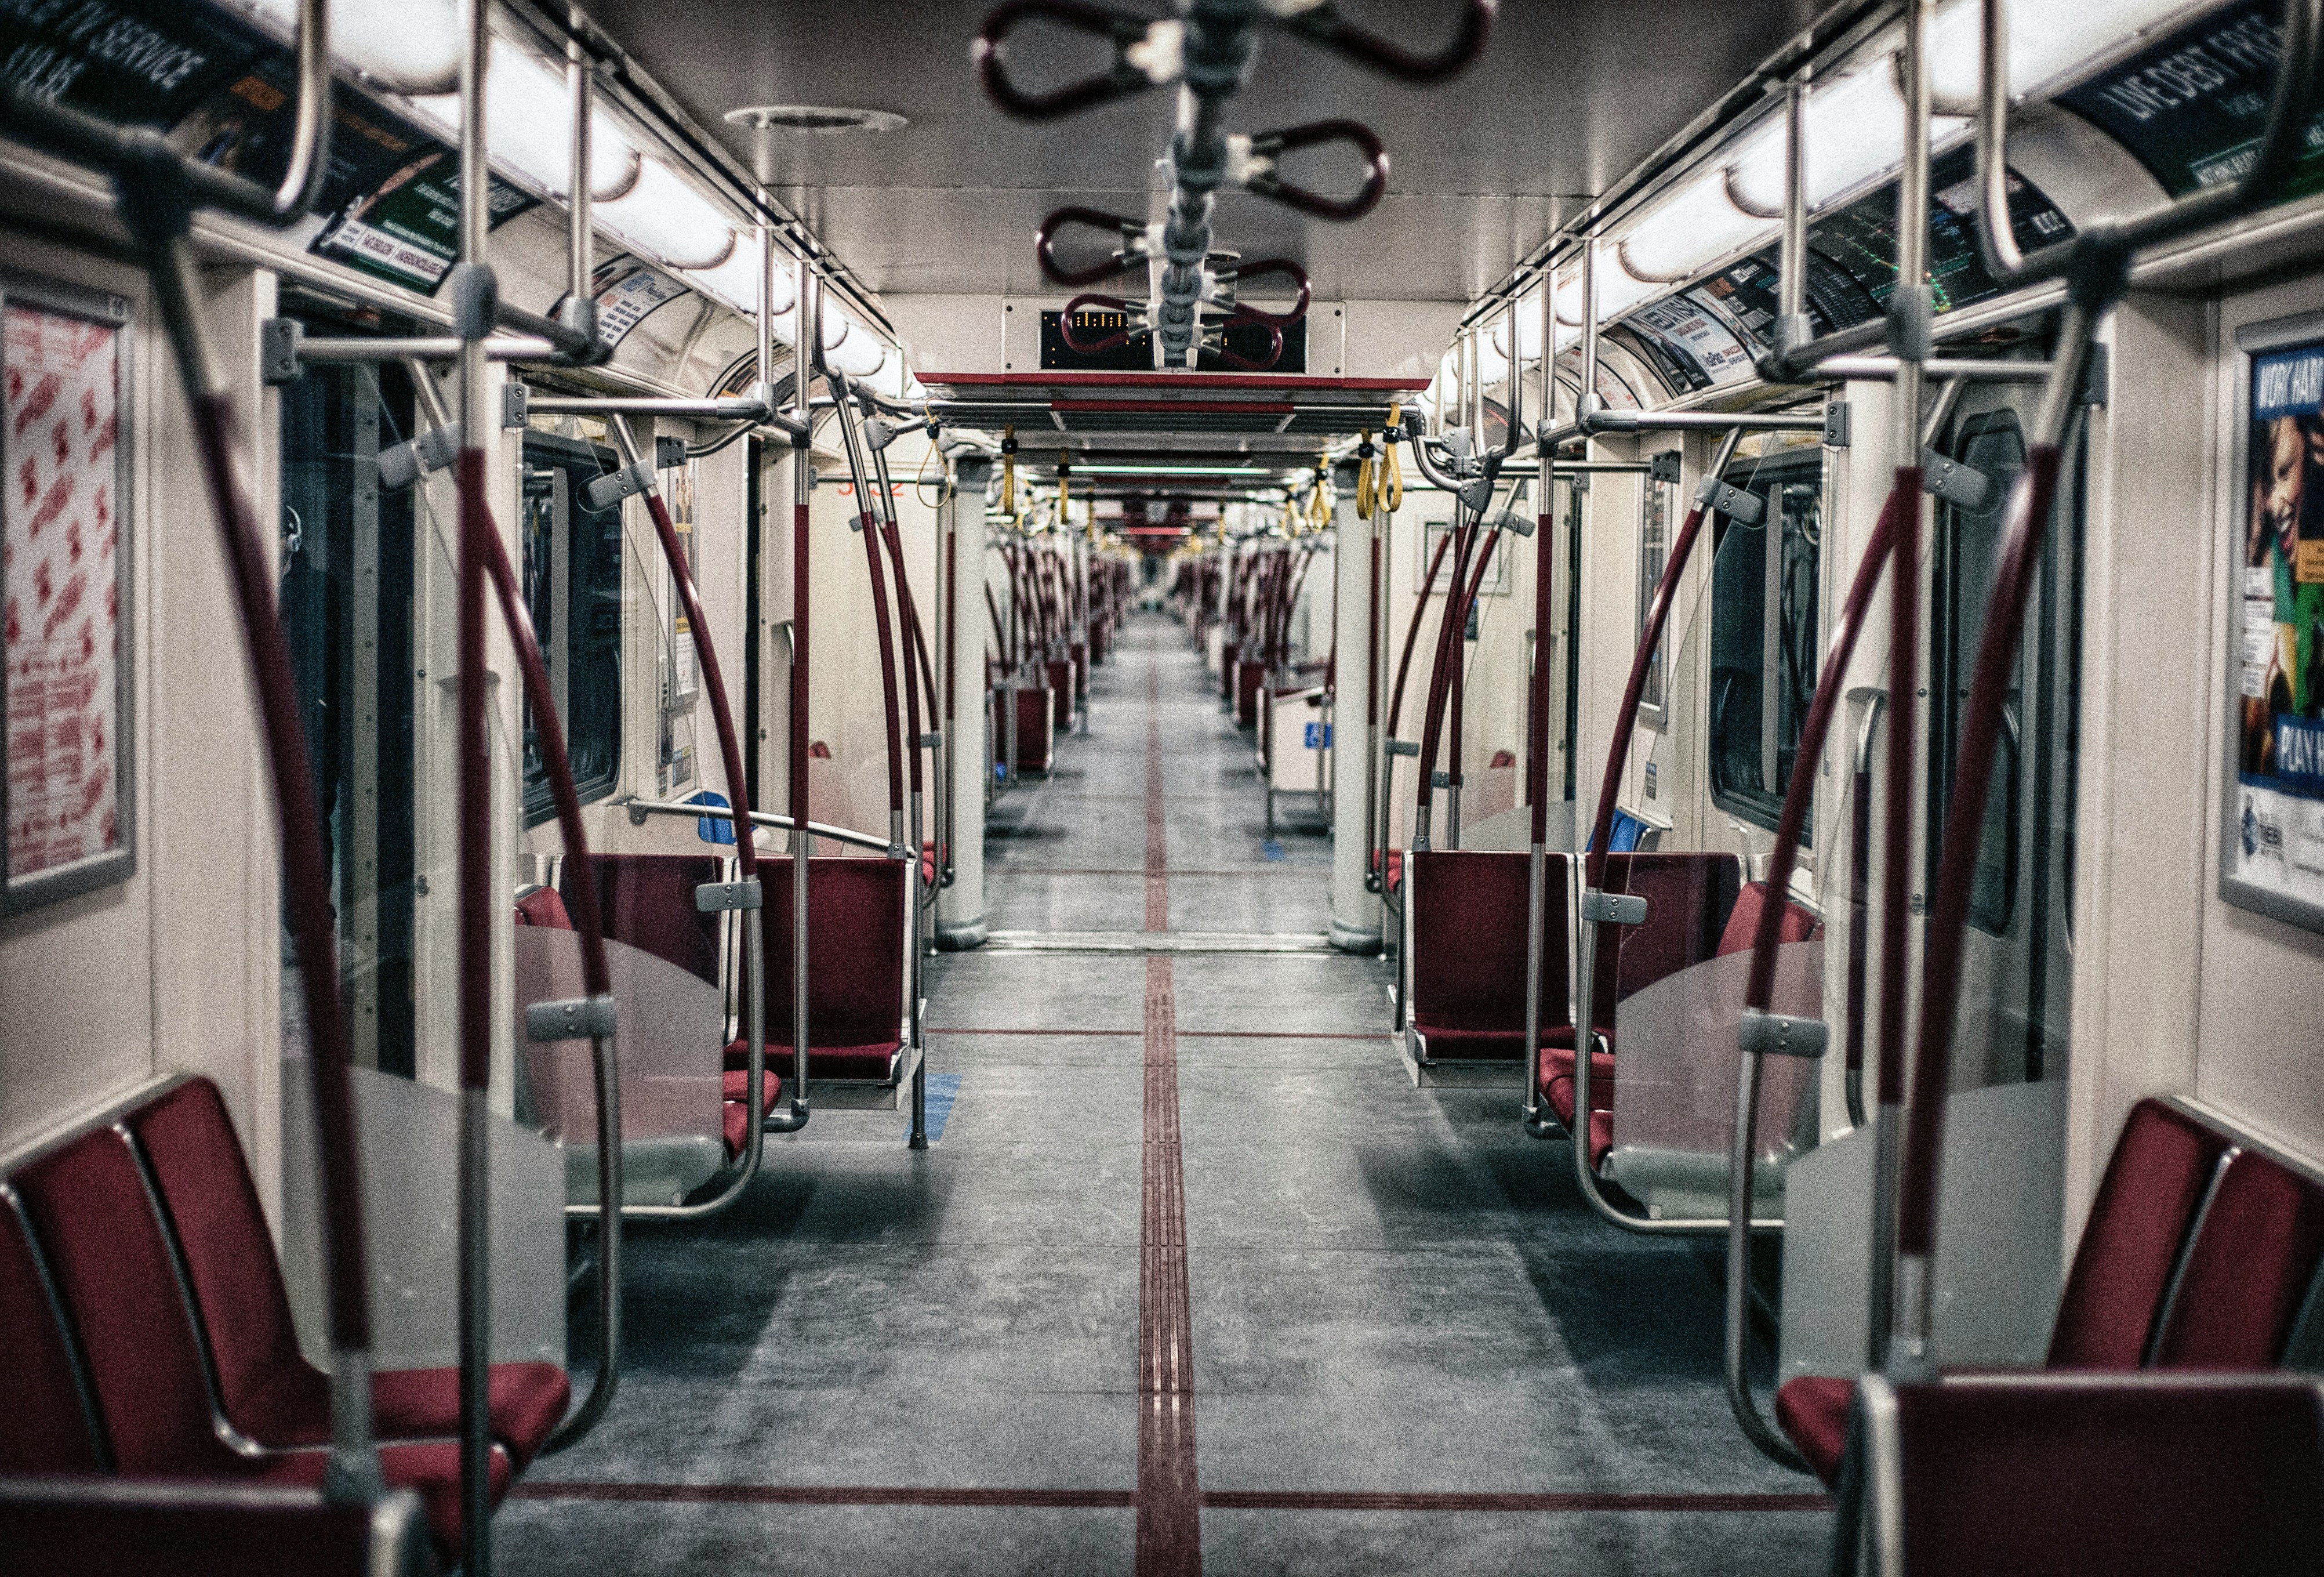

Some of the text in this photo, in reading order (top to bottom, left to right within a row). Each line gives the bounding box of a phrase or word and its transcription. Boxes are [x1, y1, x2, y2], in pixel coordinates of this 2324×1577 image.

[89, 17, 206, 90] SERVICE
[2100, 76, 2182, 119] LIVE
[2145, 46, 2238, 99] DEBT
[2258, 362, 2293, 408] WORK
[2281, 724, 2314, 774] PLAY
